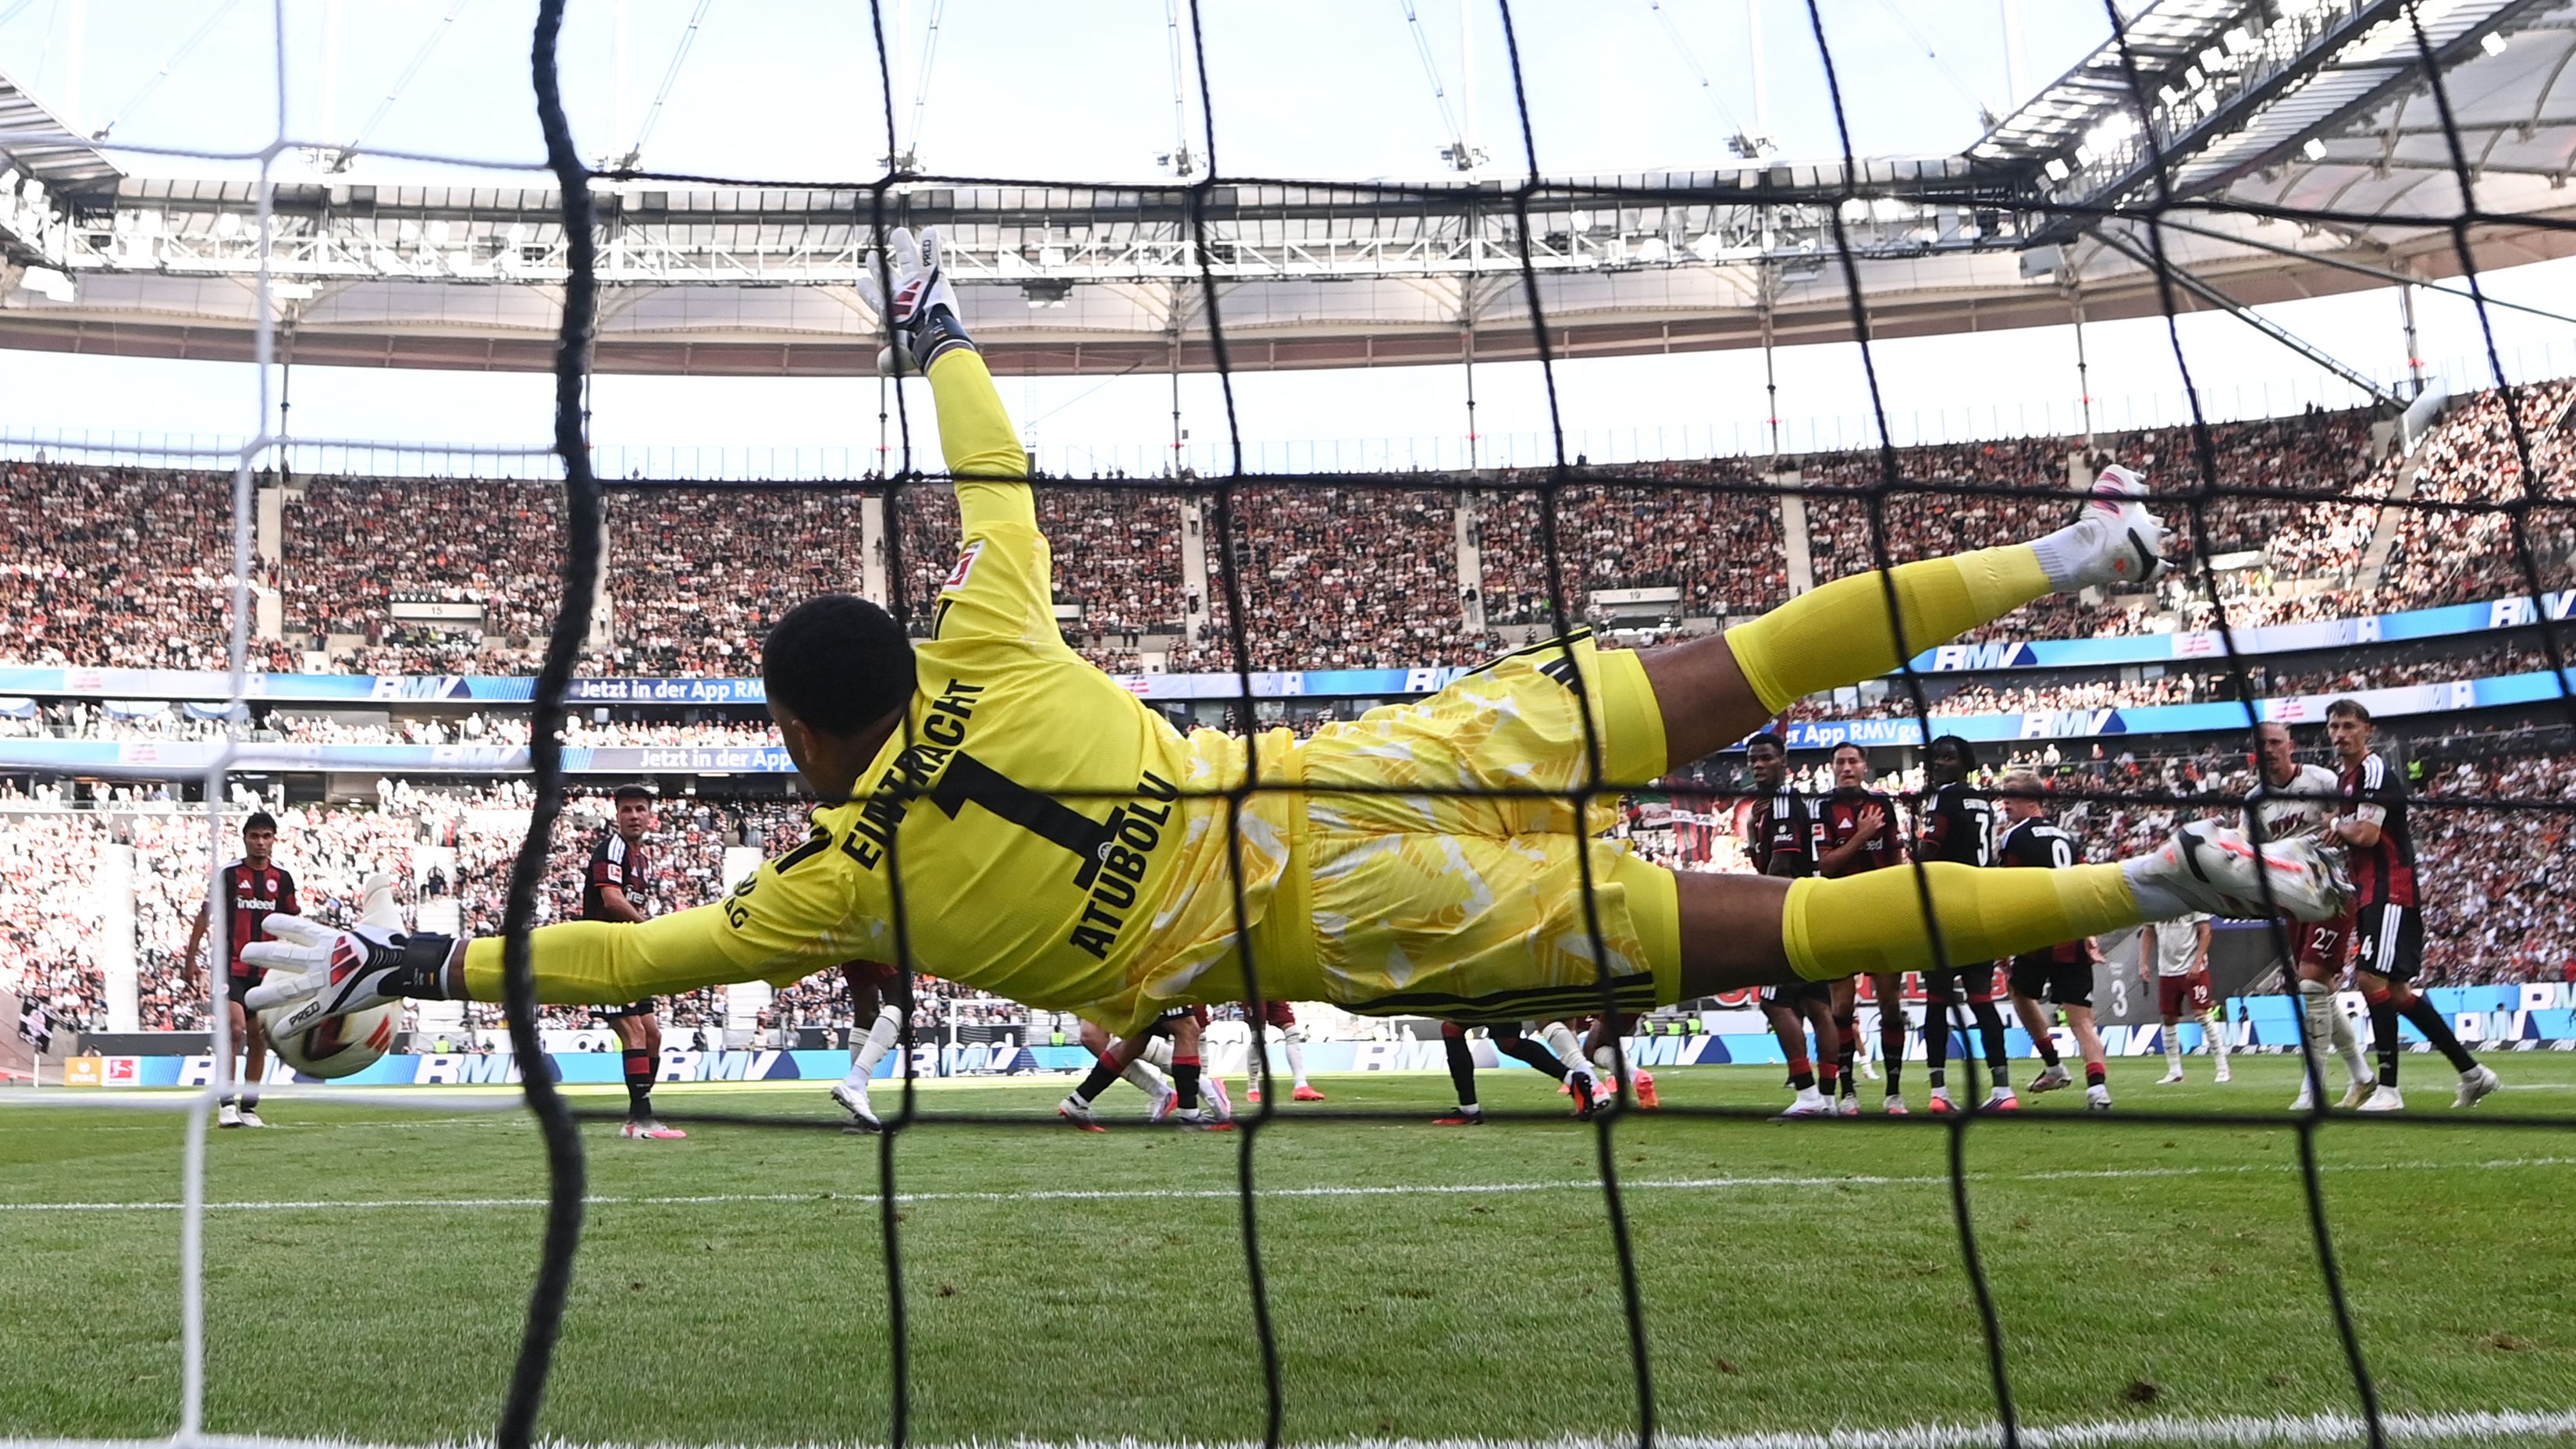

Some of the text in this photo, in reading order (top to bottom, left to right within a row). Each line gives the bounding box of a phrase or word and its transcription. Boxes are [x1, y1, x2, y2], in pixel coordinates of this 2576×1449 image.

[922, 239, 933, 267] PRED
[432, 607, 443, 615] 15
[1933, 642, 2026, 672] RMV
[371, 676, 462, 699] RMV
[580, 680, 767, 700] Jetzt in der App RM
[1804, 726, 1845, 746] App
[2019, 708, 2114, 738] RMV
[640, 749, 792, 771] Jetzt in der App
[840, 678, 986, 871] EINTRACHT
[929, 749, 1126, 892] 1
[1974, 813, 1990, 867] 3
[1068, 770, 1179, 961] ATUBOLU
[236, 895, 276, 911] indeed
[2311, 927, 2339, 951] 27
[2360, 935, 2374, 961] 4
[2111, 979, 2129, 1018] 3
[2192, 984, 2209, 1004] 19
[289, 1000, 321, 1027] PRED
[1619, 1035, 1711, 1066] MV
[656, 1051, 781, 1081] RMV
